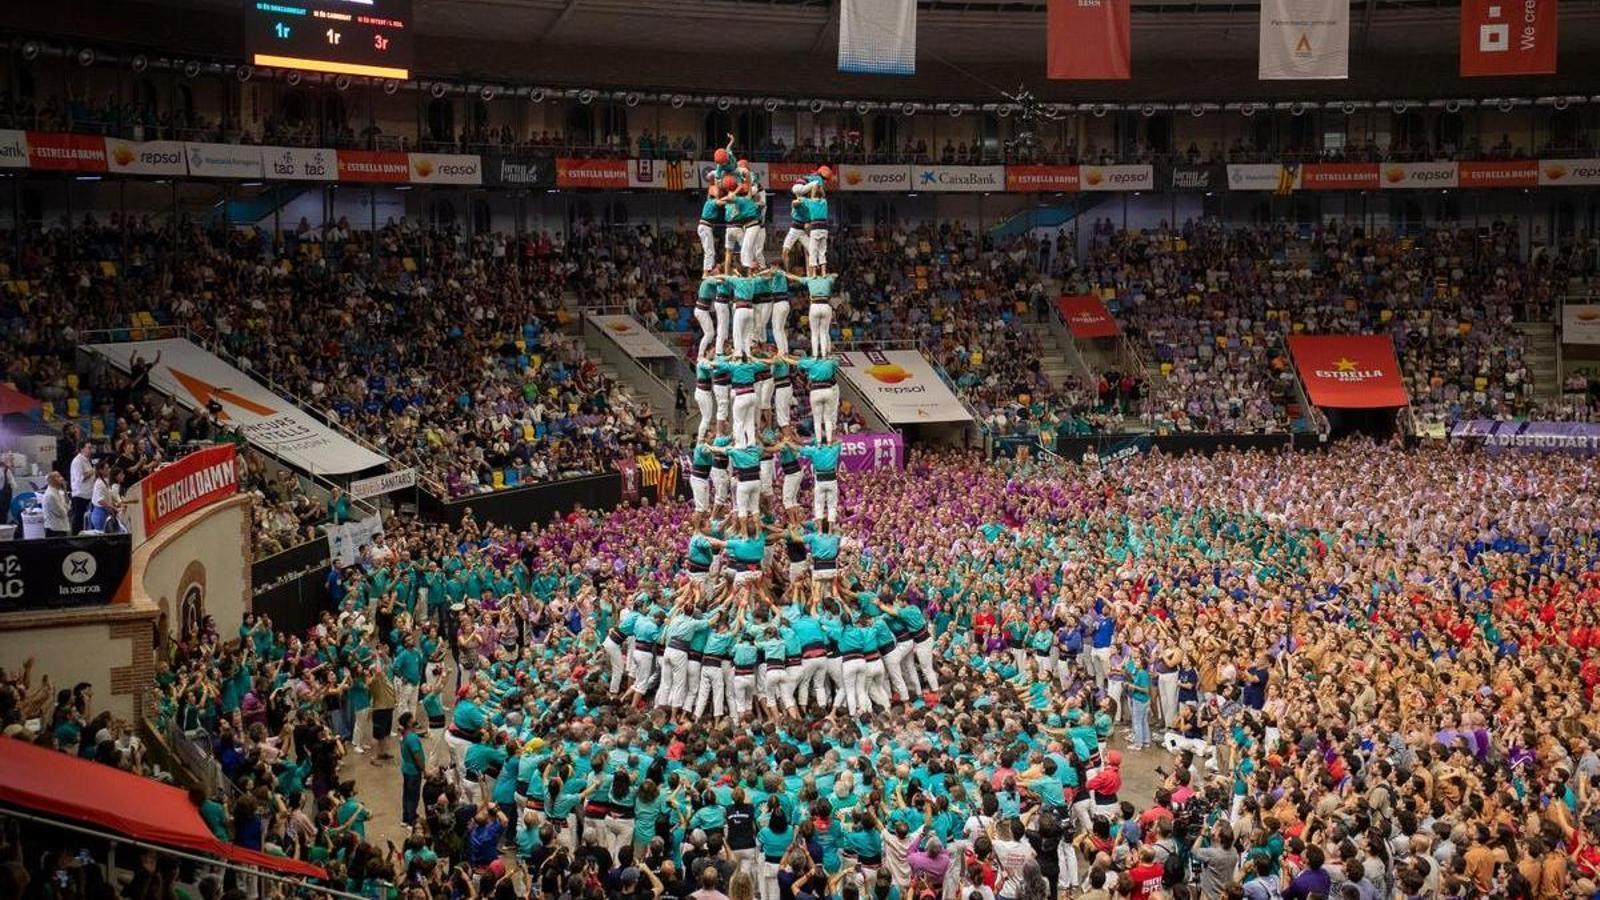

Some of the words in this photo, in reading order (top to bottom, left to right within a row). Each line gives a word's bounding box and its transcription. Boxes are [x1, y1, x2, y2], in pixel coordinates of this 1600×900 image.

[275, 22, 290, 38] 1r
[326, 28, 341, 45] 1r
[373, 34, 390, 50] 3r
[1520, 27, 1536, 51] We
[37, 148, 77, 160] ESTRELLA
[140, 152, 181, 165] repsol
[274, 162, 294, 175] tac
[305, 163, 325, 176] tac
[347, 163, 383, 173] ESTRELLA
[438, 163, 477, 176] repsol
[569, 169, 602, 179] ESTRELLA
[1411, 168, 1454, 180] repsol
[868, 172, 906, 184] repsol
[939, 172, 996, 185] CaixaBank
[1018, 175, 1053, 184] ESTRELLA
[1108, 171, 1149, 183] repsol
[1315, 173, 1352, 181] ESTRELLA
[1472, 171, 1509, 179] ESTRELLA
[1315, 369, 1383, 378] ESTRELLA
[878, 385, 926, 395] repsol
[1485, 434, 1496, 446] A
[1500, 434, 1588, 447] DISFRUTAR
[379, 472, 412, 490] SANITARIS
[157, 472, 196, 519] ESTRELLA
[195, 459, 235, 498] DAMM
[59, 585, 69, 595] la
[70, 584, 101, 594] xarxa
